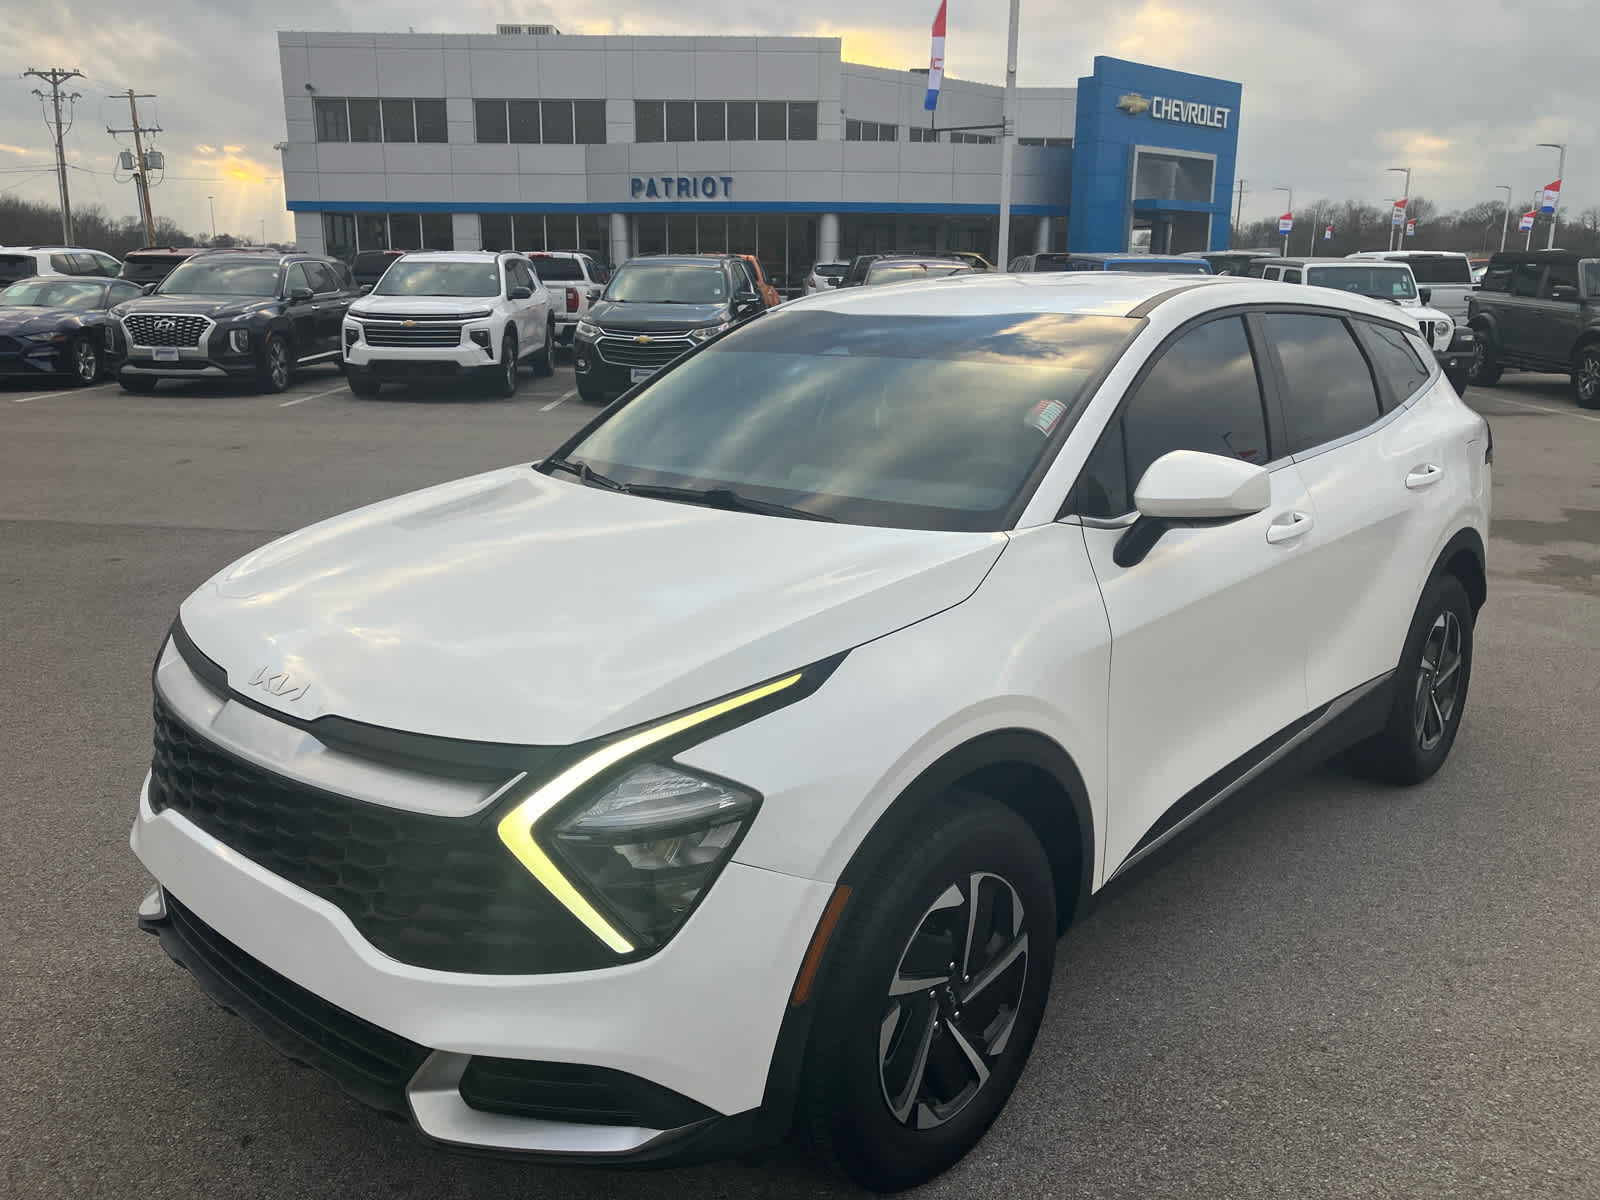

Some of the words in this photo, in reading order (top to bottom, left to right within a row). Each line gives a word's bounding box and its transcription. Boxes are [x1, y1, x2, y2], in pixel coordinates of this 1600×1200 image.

[1152, 96, 1231, 128] CHEVROLET
[631, 176, 733, 199] PATRIOT
[248, 665, 311, 702] KIA
